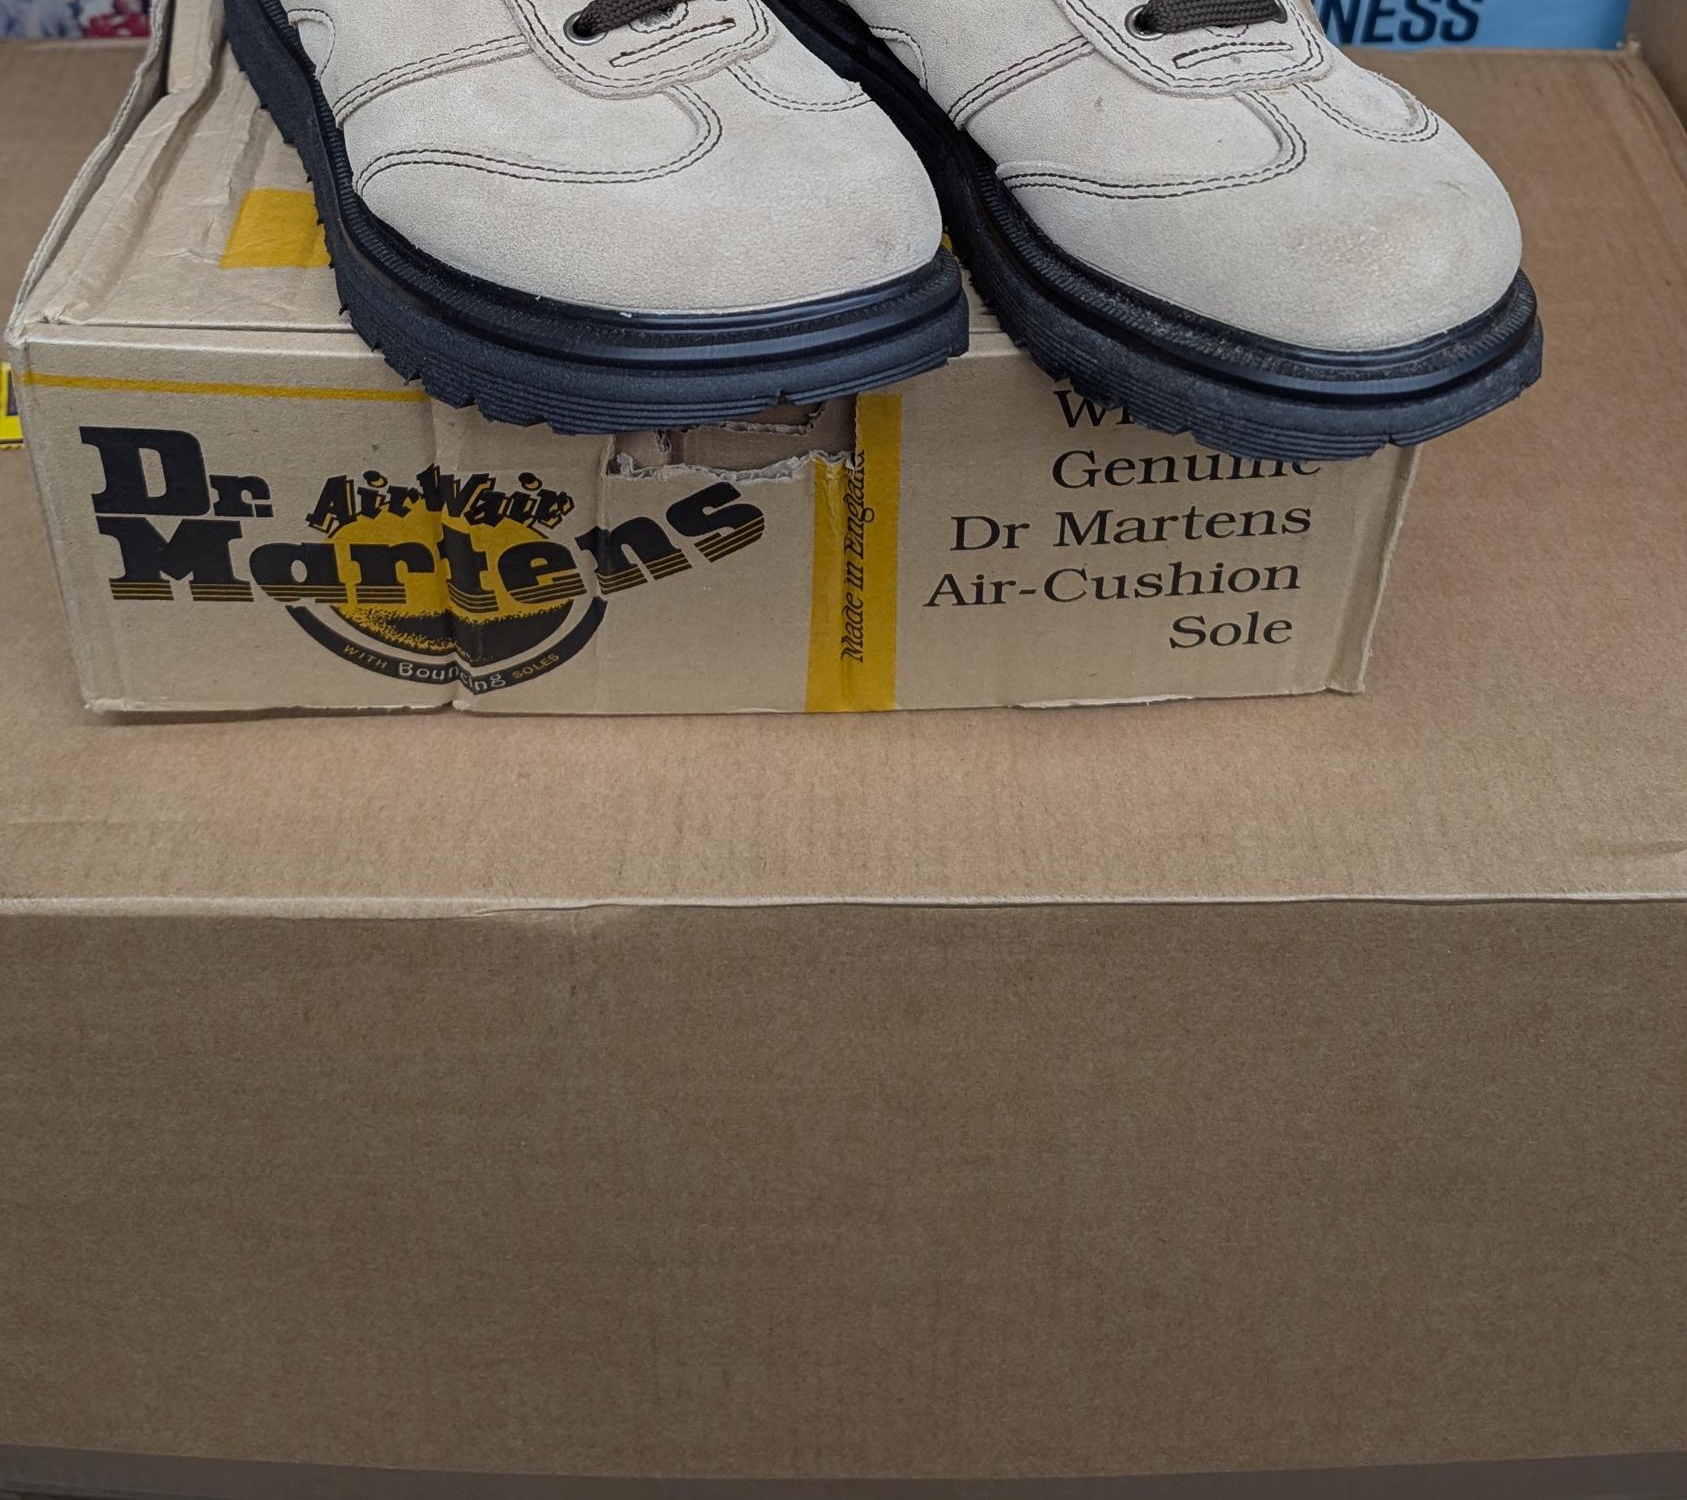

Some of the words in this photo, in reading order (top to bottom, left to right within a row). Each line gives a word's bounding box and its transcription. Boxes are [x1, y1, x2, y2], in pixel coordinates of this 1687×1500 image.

[78, 426, 274, 518] Dr.
[306, 463, 575, 537] AirWair
[96, 481, 766, 613] Martens
[949, 515, 1030, 552] Dr
[1053, 505, 1312, 549] Martens
[845, 560, 865, 591] in
[922, 560, 1302, 609] Air-Cushion
[840, 592, 866, 663] Made
[1169, 611, 1294, 650] Sole
[343, 643, 389, 670] WITH
[397, 659, 507, 694] Bouncing
[511, 652, 561, 682] SOLES
